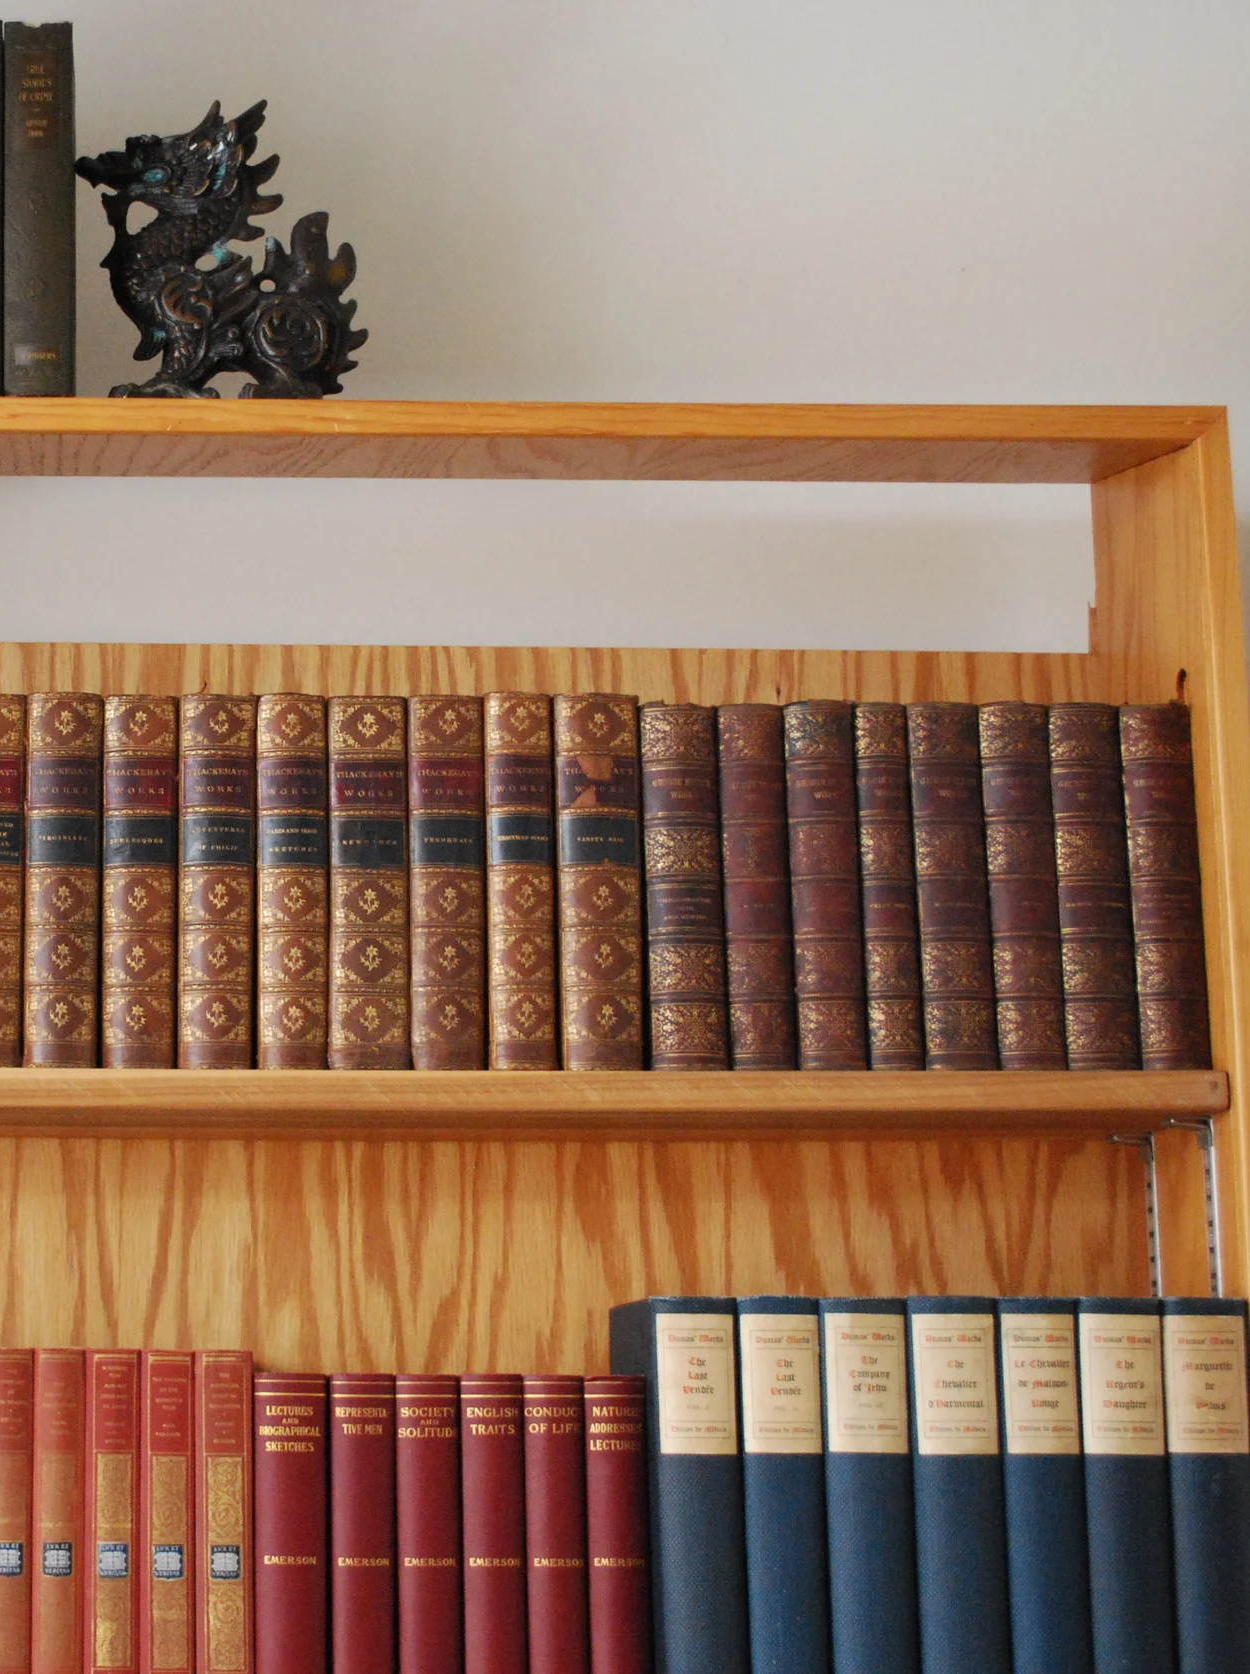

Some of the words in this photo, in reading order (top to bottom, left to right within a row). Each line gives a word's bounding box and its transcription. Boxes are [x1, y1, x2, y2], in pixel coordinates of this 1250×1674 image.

[22, 78, 52, 88] STORIES
[268, 787, 316, 795] WORKS
[689, 1357, 706, 1367] The
[776, 1359, 793, 1368] The
[861, 1355, 878, 1364] The
[946, 1360, 964, 1369] The
[1014, 1360, 1026, 1368] Le
[1029, 1360, 1070, 1368] Chevalier
[1116, 1360, 1134, 1369] The
[1182, 1363, 1233, 1372] Marguerite
[688, 1372, 708, 1380] Last
[776, 1373, 796, 1382] Last
[850, 1370, 890, 1380] Company
[853, 1383, 862, 1392] of
[866, 1383, 887, 1392] Jehu
[934, 1380, 977, 1388] Chevalier
[1106, 1380, 1144, 1390] Regent's
[1205, 1382, 1214, 1390] de
[683, 1385, 714, 1394] Vendée
[770, 1386, 801, 1395] Vendée
[1031, 1400, 1059, 1408] Rouge
[1103, 1400, 1147, 1410] Daughter
[266, 1406, 313, 1416] LECTURES
[335, 1408, 387, 1418] REPRESENTA
[400, 1407, 455, 1417] SOCIETY
[467, 1407, 518, 1418] ENGLISH
[524, 1407, 580, 1418] CONDUC
[592, 1407, 639, 1417] NATURE
[259, 1426, 320, 1436] BIOGRAPHICAL
[342, 1424, 363, 1435] TIVE
[365, 1424, 382, 1435] MEN
[470, 1424, 515, 1435] TRAITS
[529, 1424, 547, 1433] OF
[590, 1423, 641, 1433] ADDRESSES
[265, 1442, 314, 1452] SKETCHES
[590, 1440, 641, 1450] LECTURES
[263, 1555, 317, 1565] EMERSON
[338, 1557, 389, 1566] EMERSON
[404, 1557, 456, 1566] EMERSON
[469, 1557, 520, 1567] EMERSON
